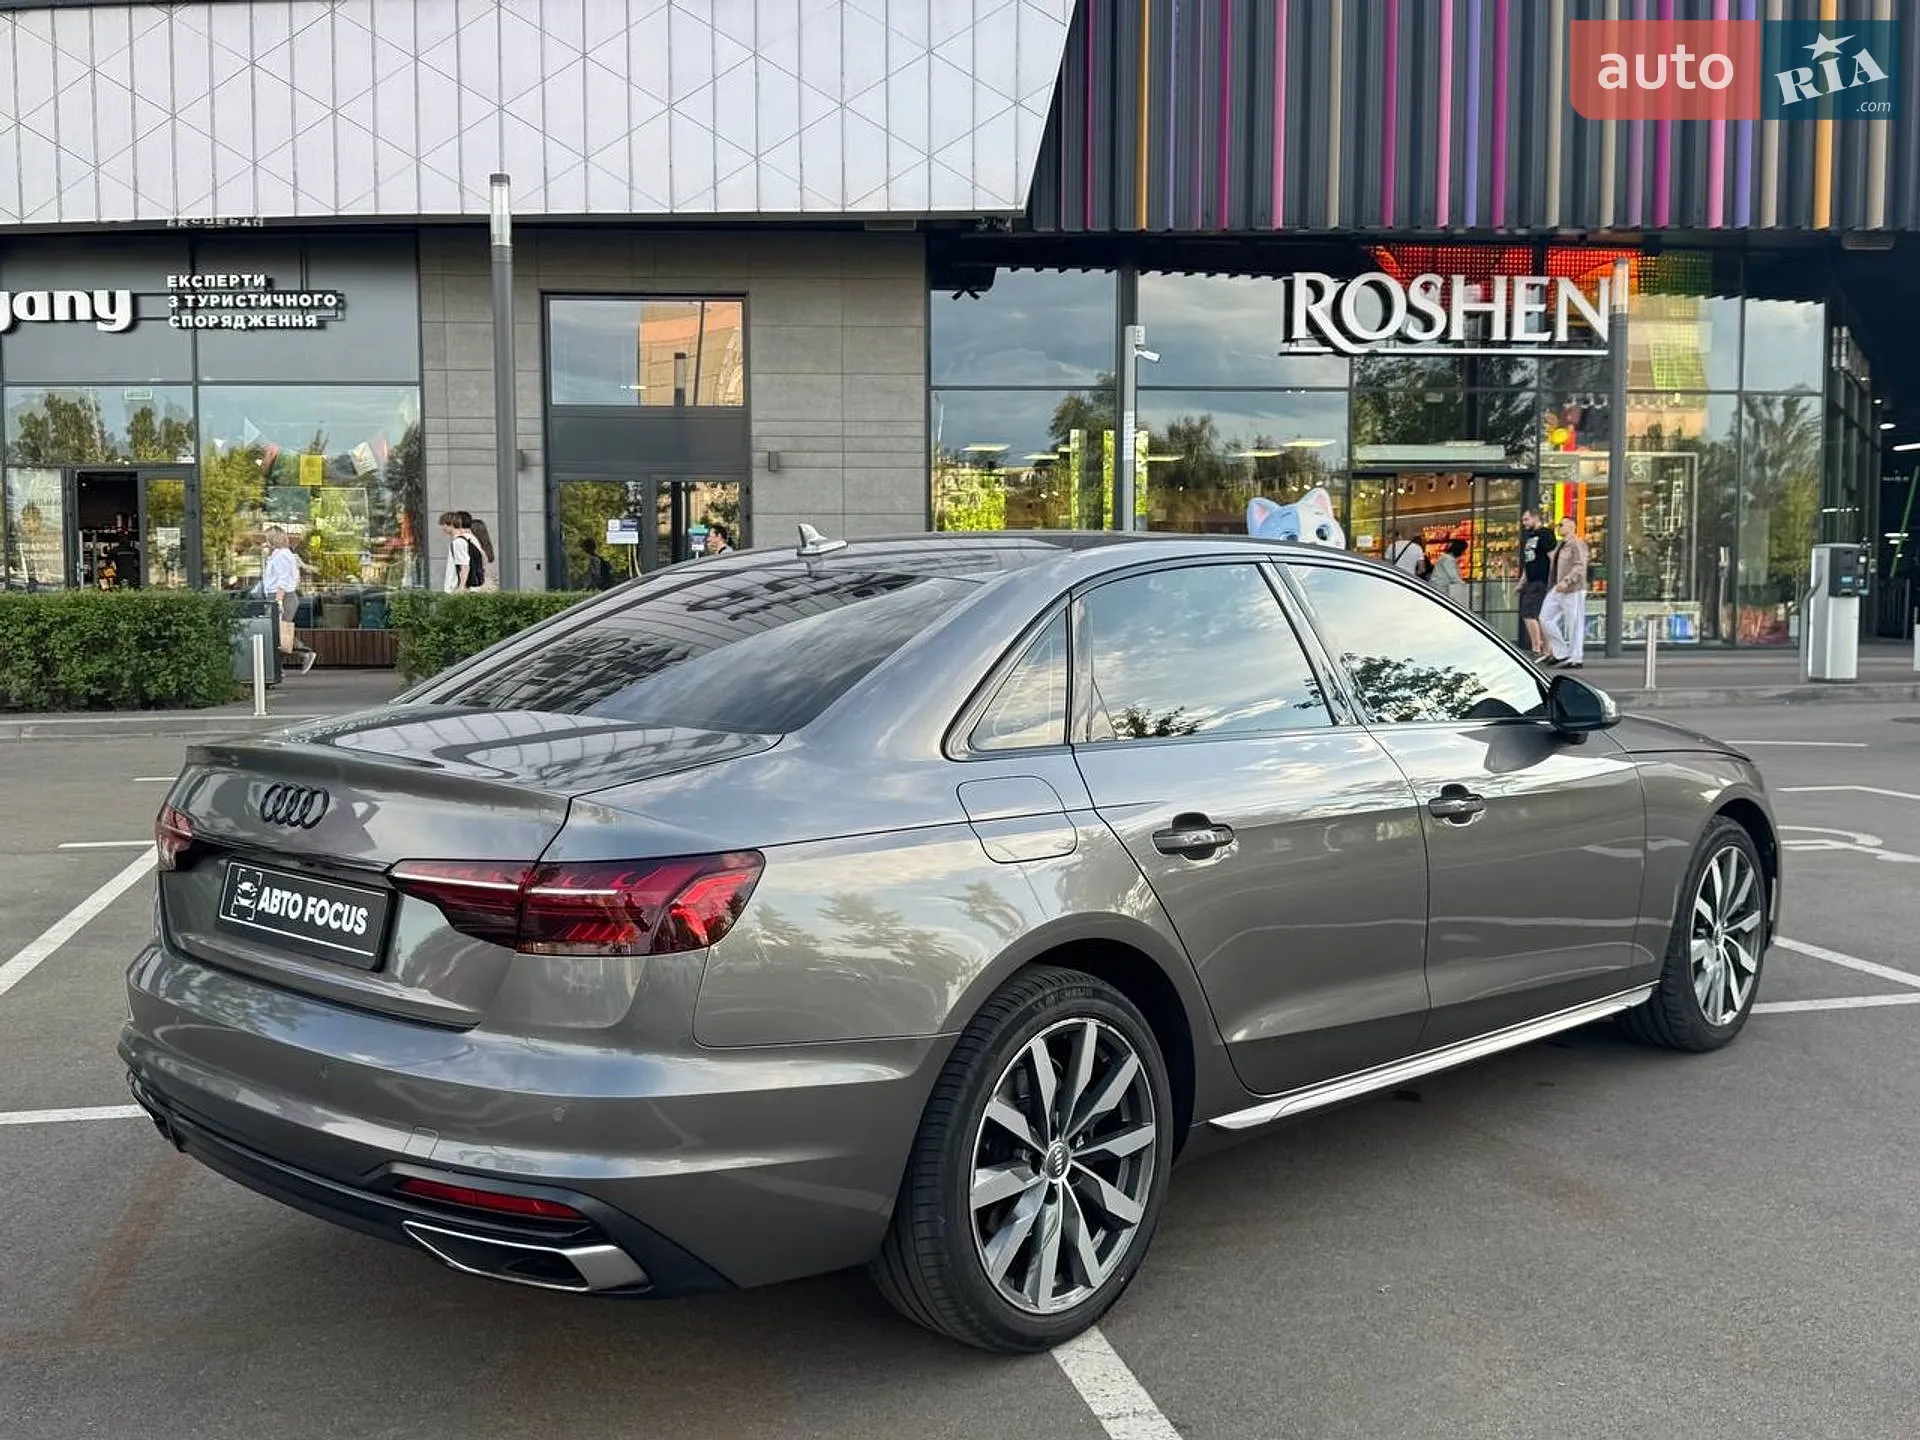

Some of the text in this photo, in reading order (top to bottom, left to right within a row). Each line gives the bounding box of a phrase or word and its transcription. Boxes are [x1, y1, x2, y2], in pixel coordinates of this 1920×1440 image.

[167, 274, 266, 288] ЕКСПЕРТИ
[184, 294, 337, 308] ТУРИСТИЧНОГО
[1291, 272, 1610, 353] ROSHEN
[168, 314, 318, 331] СПОРЯДЖЕННЯ
[303, 895, 369, 936] FOCUS
